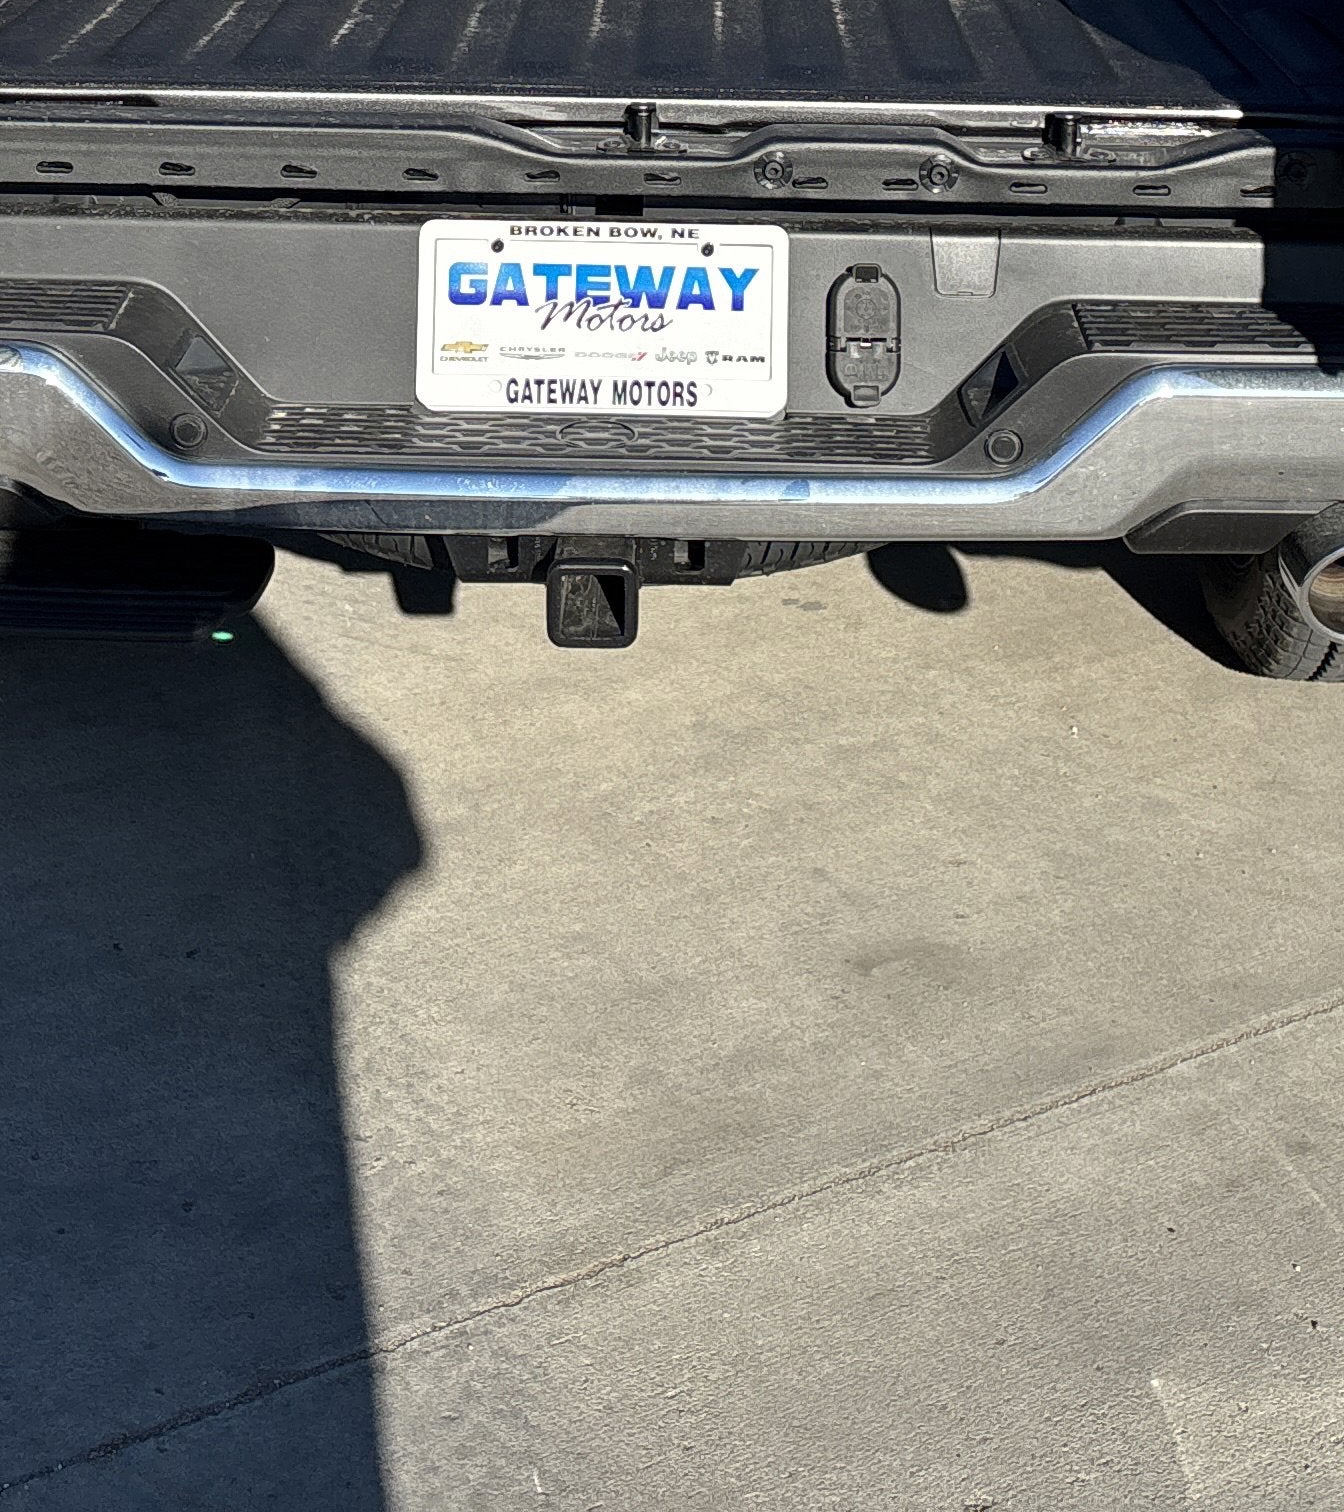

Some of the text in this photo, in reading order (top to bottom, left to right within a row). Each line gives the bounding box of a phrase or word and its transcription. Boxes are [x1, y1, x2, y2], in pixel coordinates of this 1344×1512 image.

[509, 224, 700, 240] BROKEN BOW, NE
[447, 261, 760, 312] GATEWAY
[534, 296, 674, 333] Motors
[655, 347, 698, 365] Jeep
[721, 354, 766, 363] RAM
[506, 377, 698, 407] GATEWAY MOTORS
